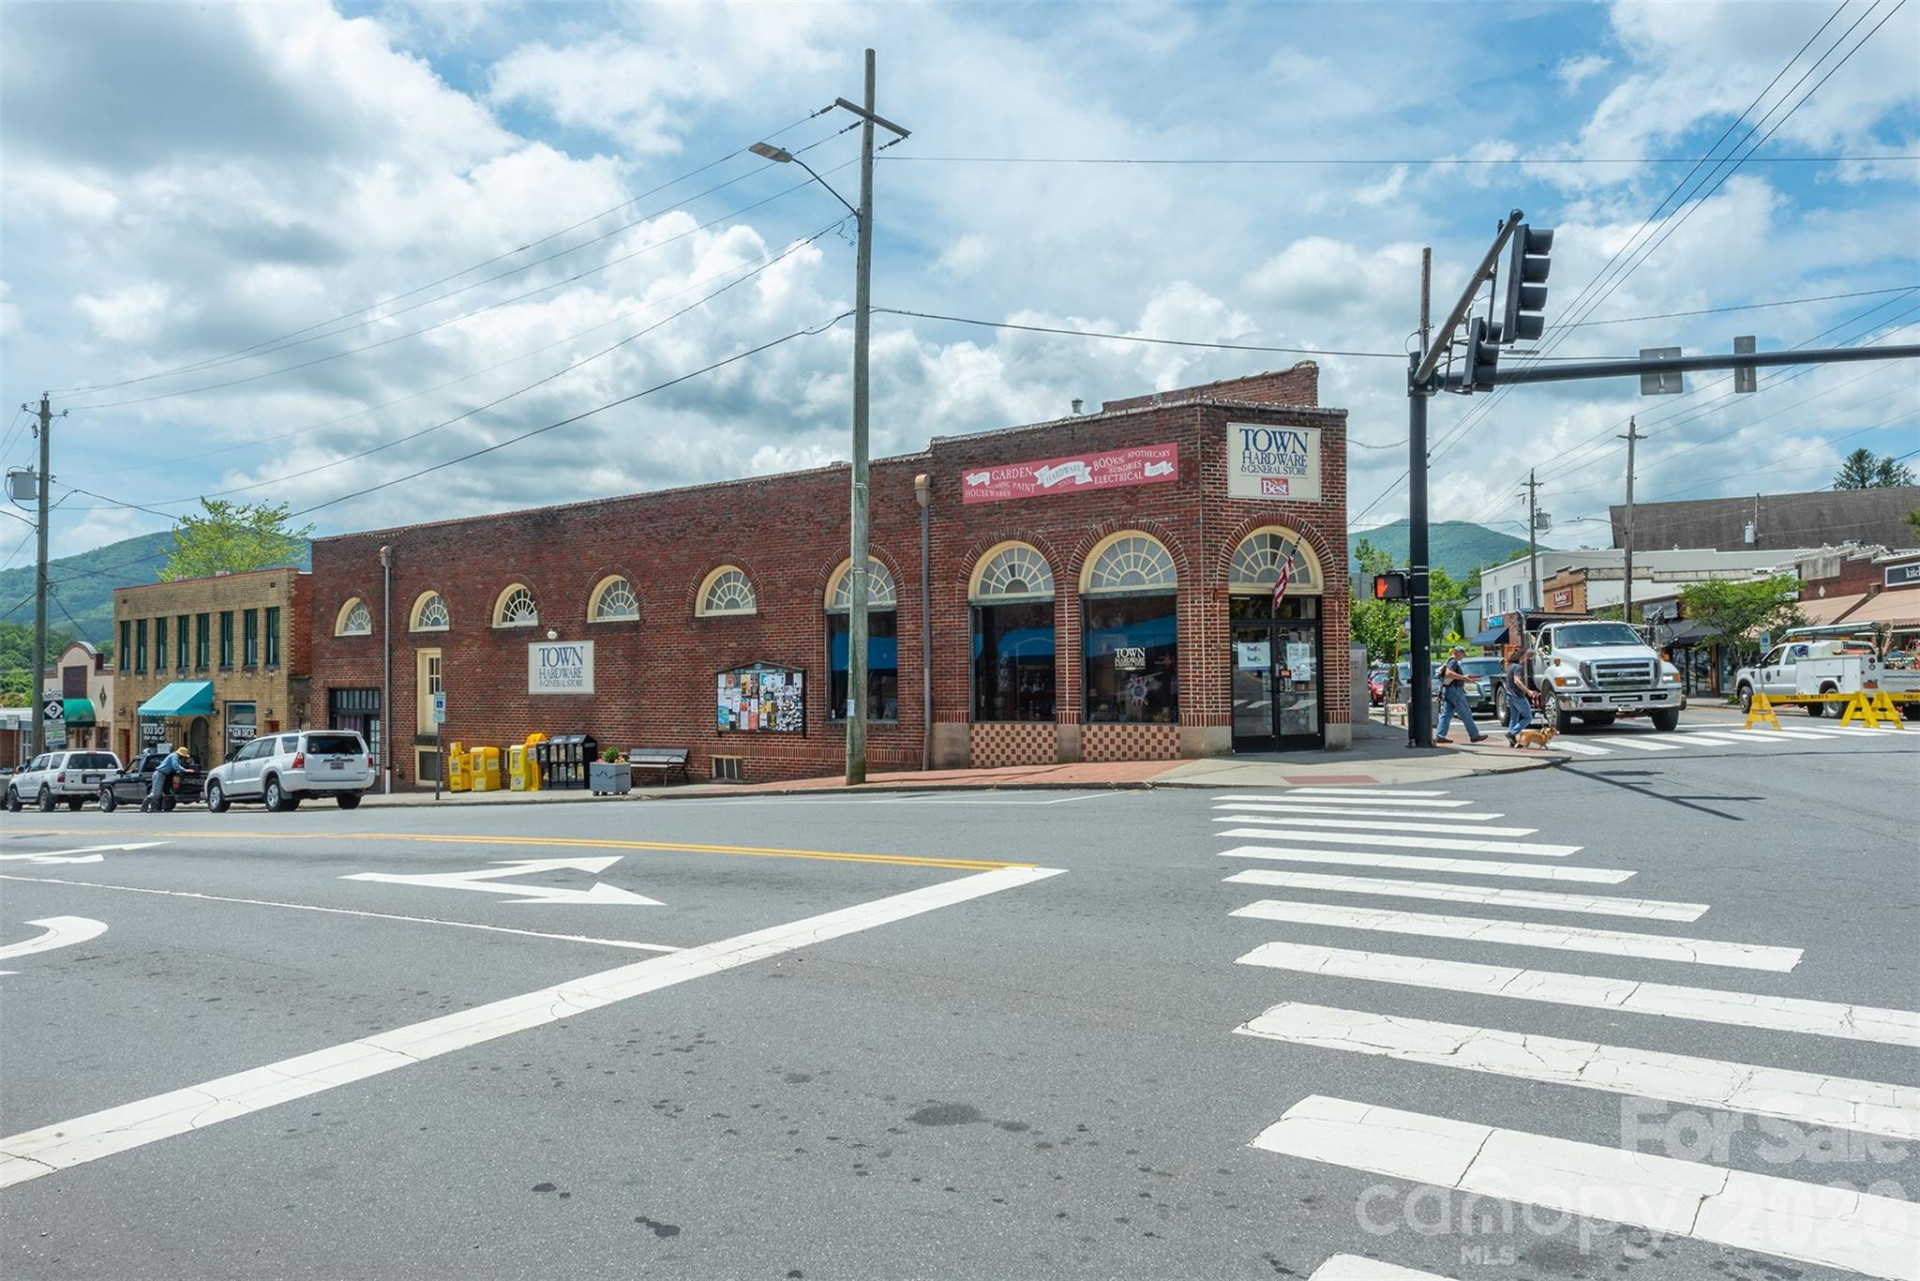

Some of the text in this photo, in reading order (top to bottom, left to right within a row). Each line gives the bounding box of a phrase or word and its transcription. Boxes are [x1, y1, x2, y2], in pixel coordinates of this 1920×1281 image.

[1239, 428, 1309, 454] TOWN
[1127, 449, 1171, 459] APOTHECARY
[1242, 451, 1308, 467] HARDWARE
[1093, 456, 1124, 471] BOOKS
[1109, 460, 1142, 473] SUNDRIES
[991, 467, 1033, 481] GARDEN
[1247, 464, 1281, 475] GENERAL
[1283, 466, 1307, 476] STORE
[1094, 471, 1143, 484] ELECTRICAL
[965, 488, 1011, 498] HOUSEWARES
[1012, 482, 1035, 494] PAINT
[1262, 480, 1288, 495] Best
[538, 646, 584, 668] TOWN
[1114, 647, 1146, 658] TOWN
[539, 667, 583, 679] HARDWARE
[50, 704, 58, 715] 9
[1387, 704, 1407, 713] OPEN
